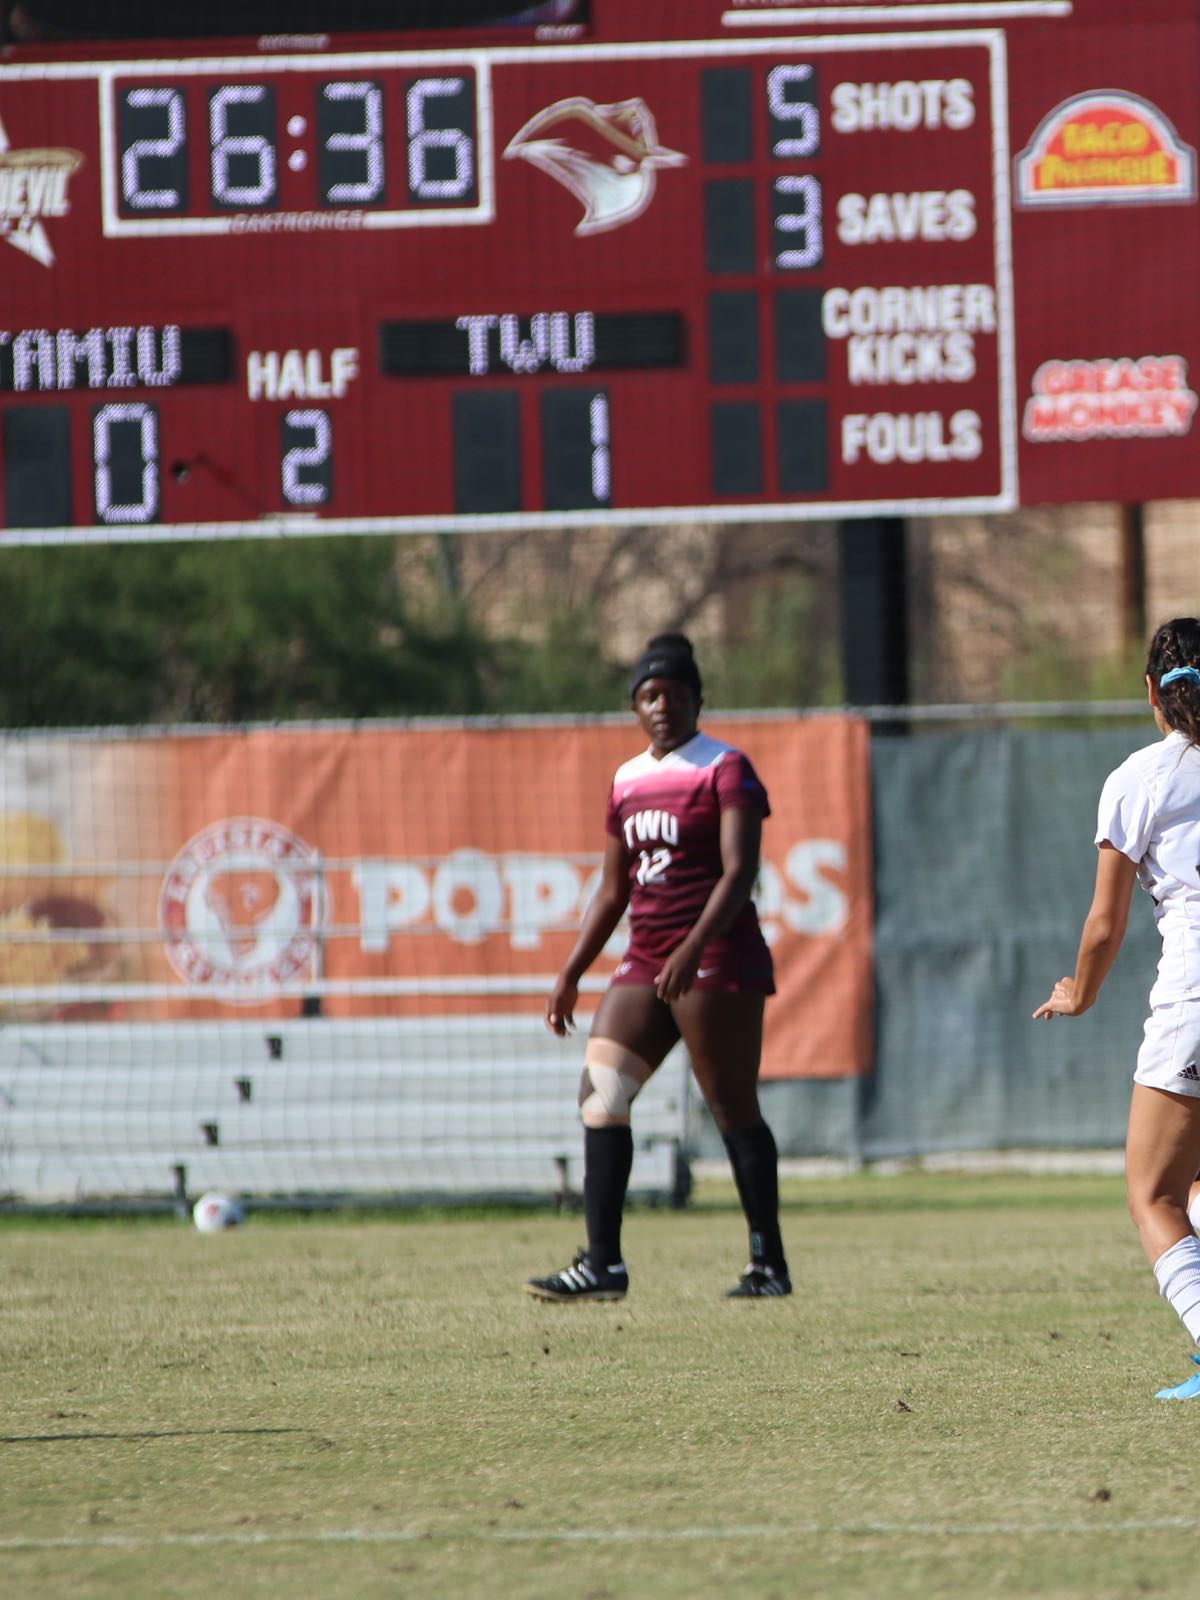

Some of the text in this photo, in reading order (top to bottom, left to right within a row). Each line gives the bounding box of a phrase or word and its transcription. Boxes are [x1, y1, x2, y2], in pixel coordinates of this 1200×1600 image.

[767, 64, 820, 158] 5
[831, 78, 976, 133] SHOTS
[122, 78, 473, 209] 26:36
[774, 175, 823, 270] 3
[836, 190, 977, 246] SAVES
[822, 284, 997, 338] CORNER
[456, 311, 595, 376] TWU
[848, 332, 976, 385] KICKS
[247, 348, 359, 401] HALF
[93, 402, 160, 525] 0
[281, 409, 332, 505] 2
[590, 392, 610, 501] 1
[842, 410, 982, 465] FOULS
[623, 809, 678, 849] TWU
[352, 838, 849, 956] POPS
[636, 848, 672, 886] 12
